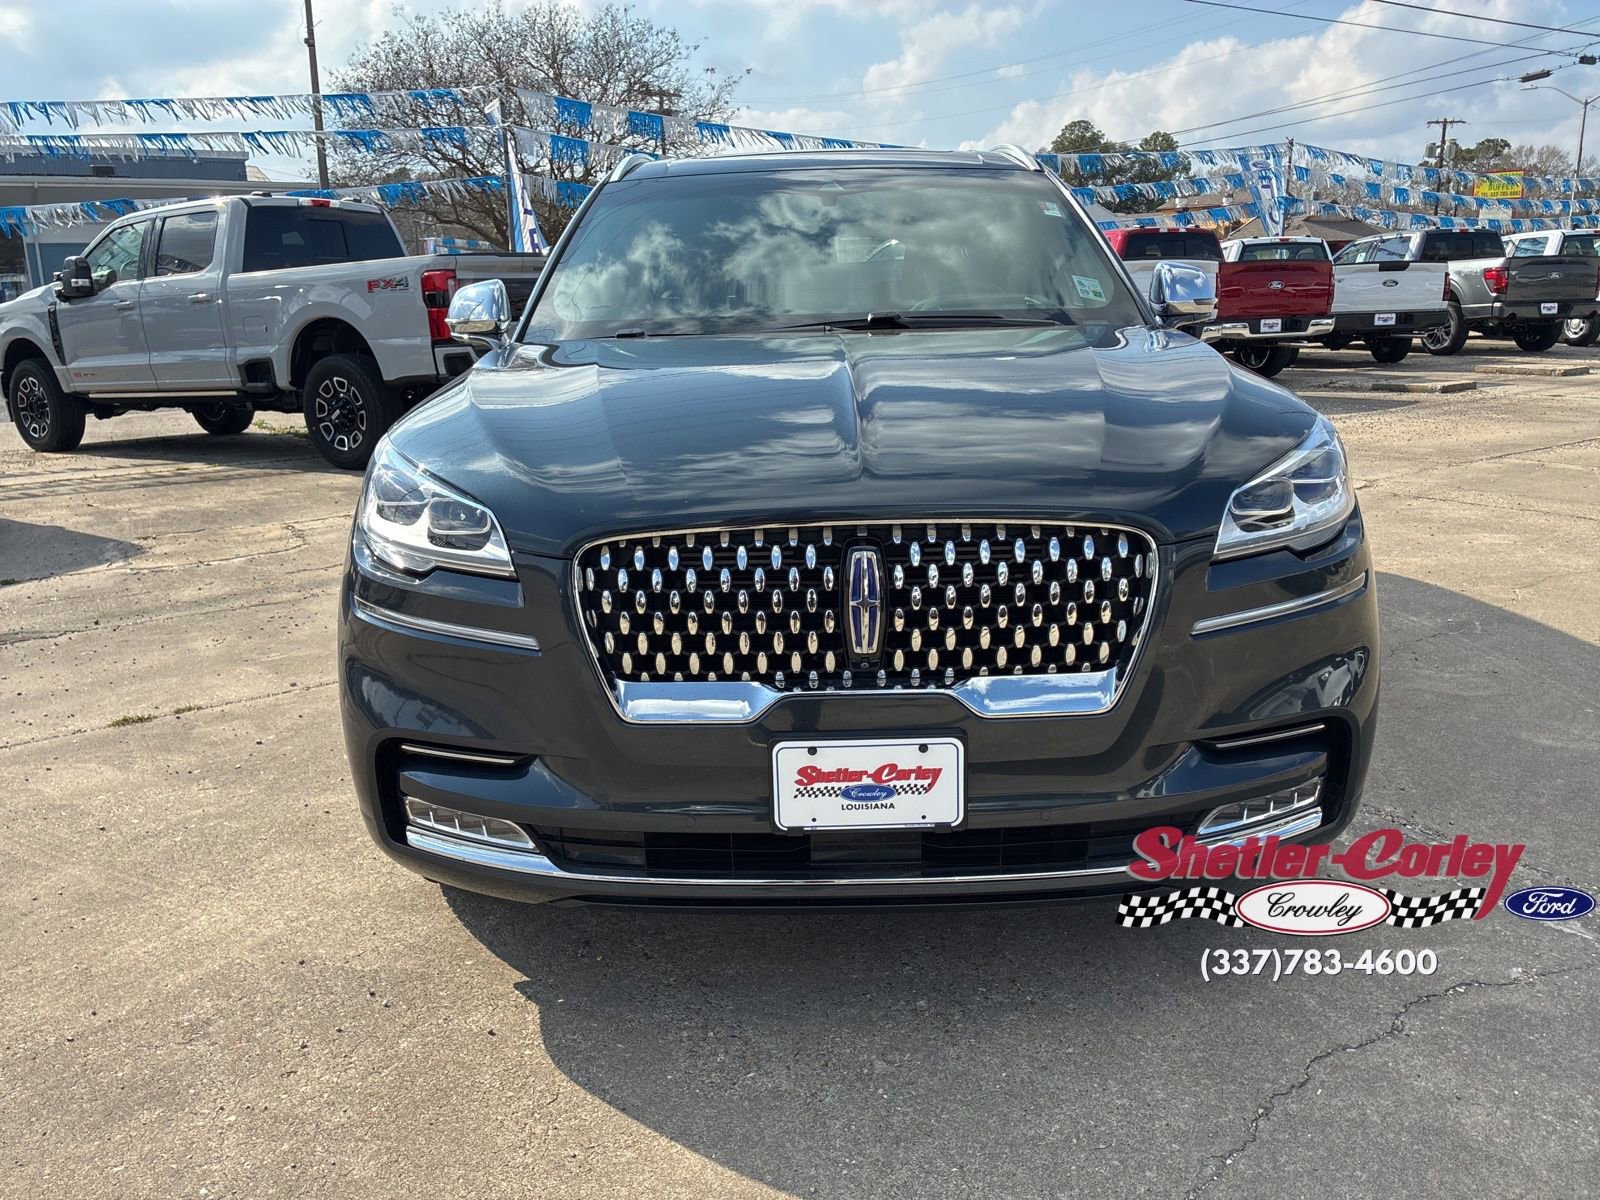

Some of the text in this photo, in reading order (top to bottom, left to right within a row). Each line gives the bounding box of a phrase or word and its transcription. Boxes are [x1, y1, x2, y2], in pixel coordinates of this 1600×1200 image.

[367, 276, 409, 291] FX4
[794, 763, 943, 794] Shetler-Corley
[849, 786, 888, 799] Crowley
[841, 802, 896, 811] LOUISIANA
